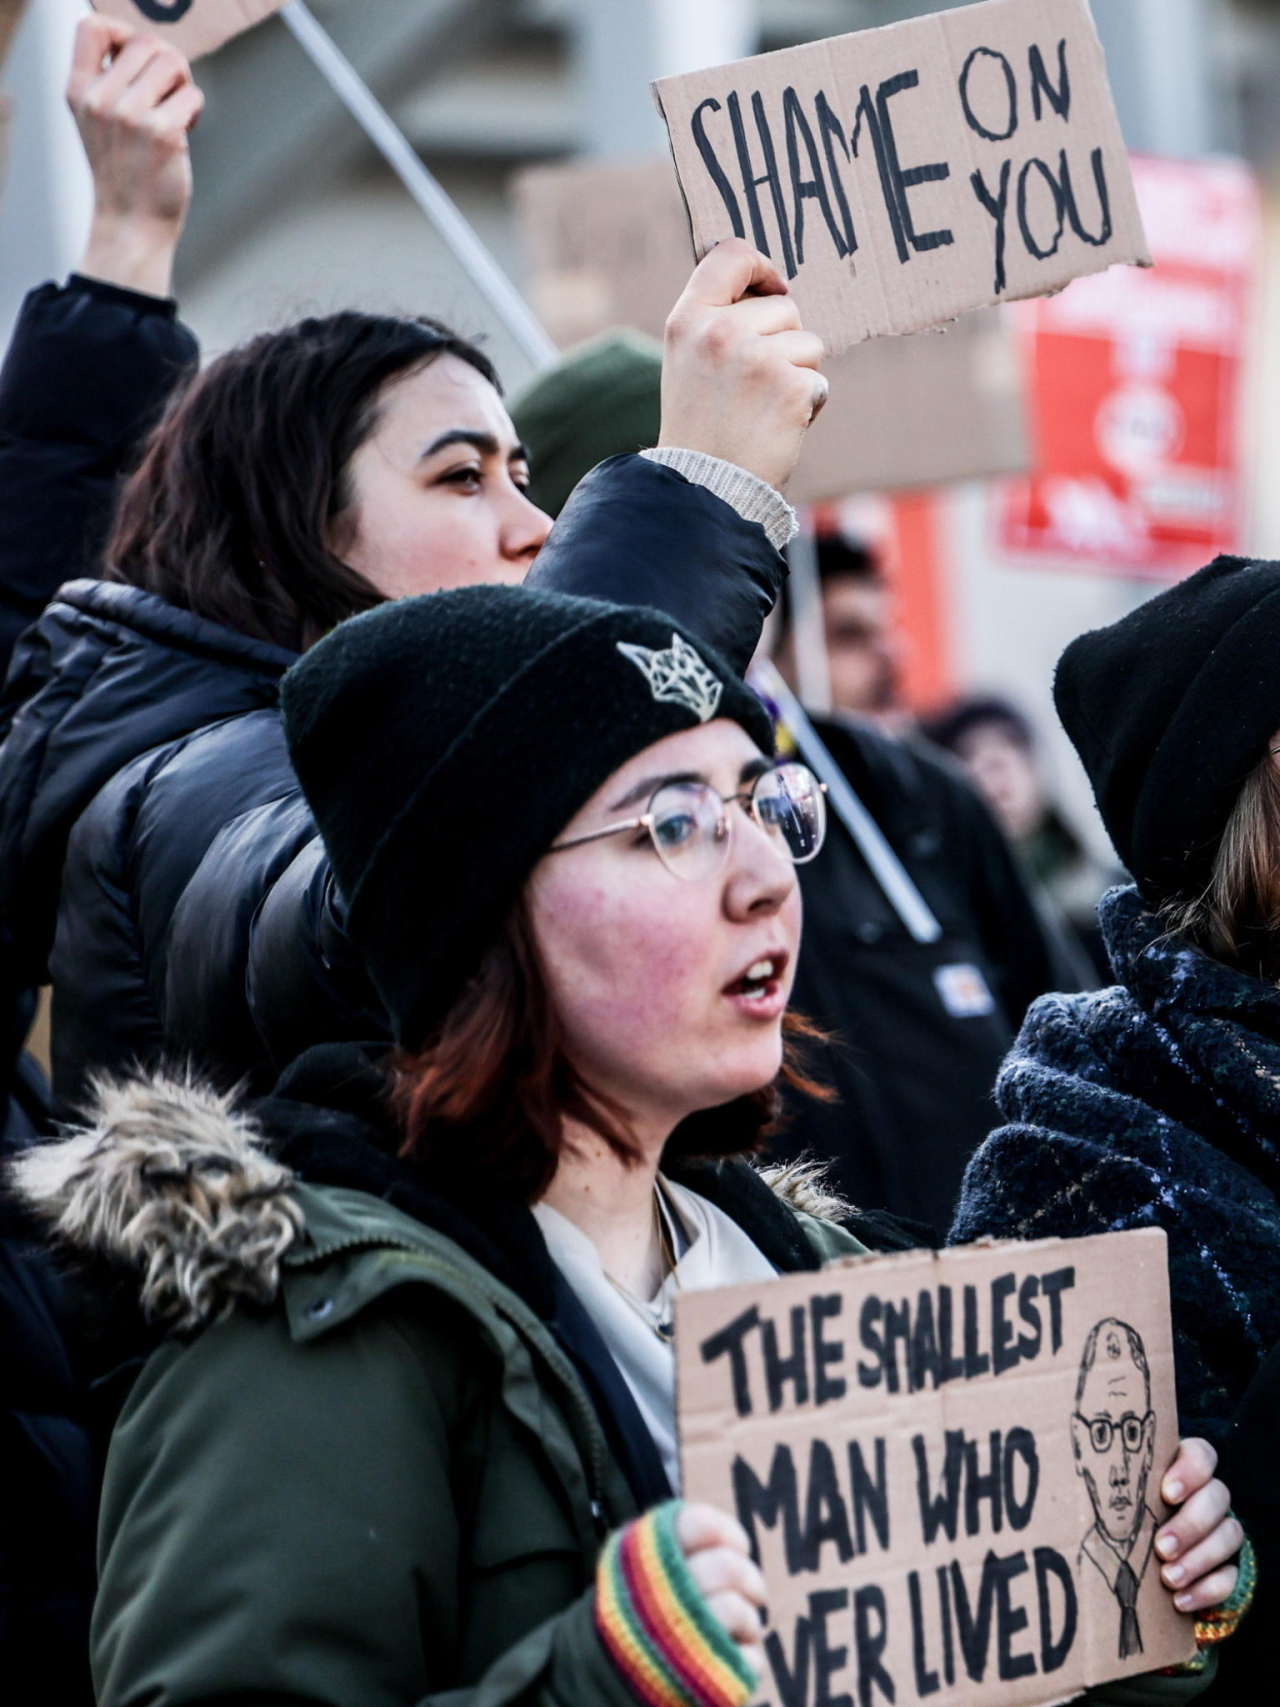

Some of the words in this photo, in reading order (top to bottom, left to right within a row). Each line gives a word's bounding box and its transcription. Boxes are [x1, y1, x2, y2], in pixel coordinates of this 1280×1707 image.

[691, 69, 955, 280] SHAME
[958, 38, 1070, 142] ON
[970, 146, 1112, 295] YOU
[700, 1293, 848, 1417] THE
[857, 1266, 1077, 1395] SMALLEST
[731, 1437, 891, 1577] MAN
[911, 1425, 1040, 1546] WHO
[752, 1584, 897, 1707] VER
[908, 1547, 1079, 1699] LIVED
